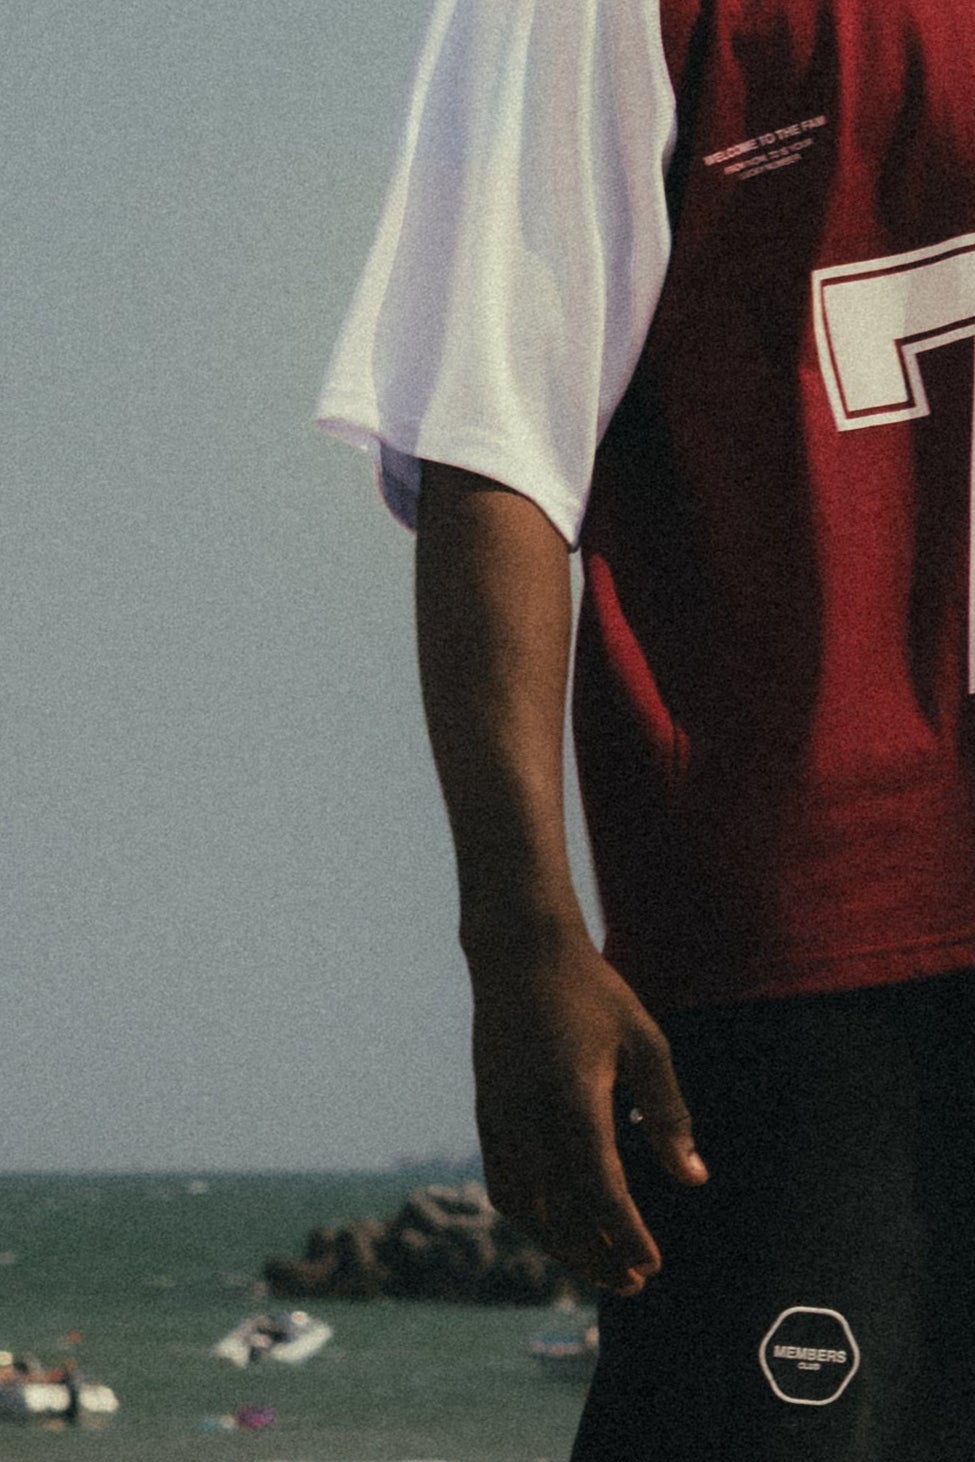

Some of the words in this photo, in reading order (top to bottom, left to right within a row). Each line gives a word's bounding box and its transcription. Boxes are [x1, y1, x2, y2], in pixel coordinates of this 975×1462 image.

[702, 138, 759, 166] WELCOME
[758, 132, 776, 146] TO
[774, 123, 801, 140] THE
[772, 1344, 847, 1364] MEMBERS
